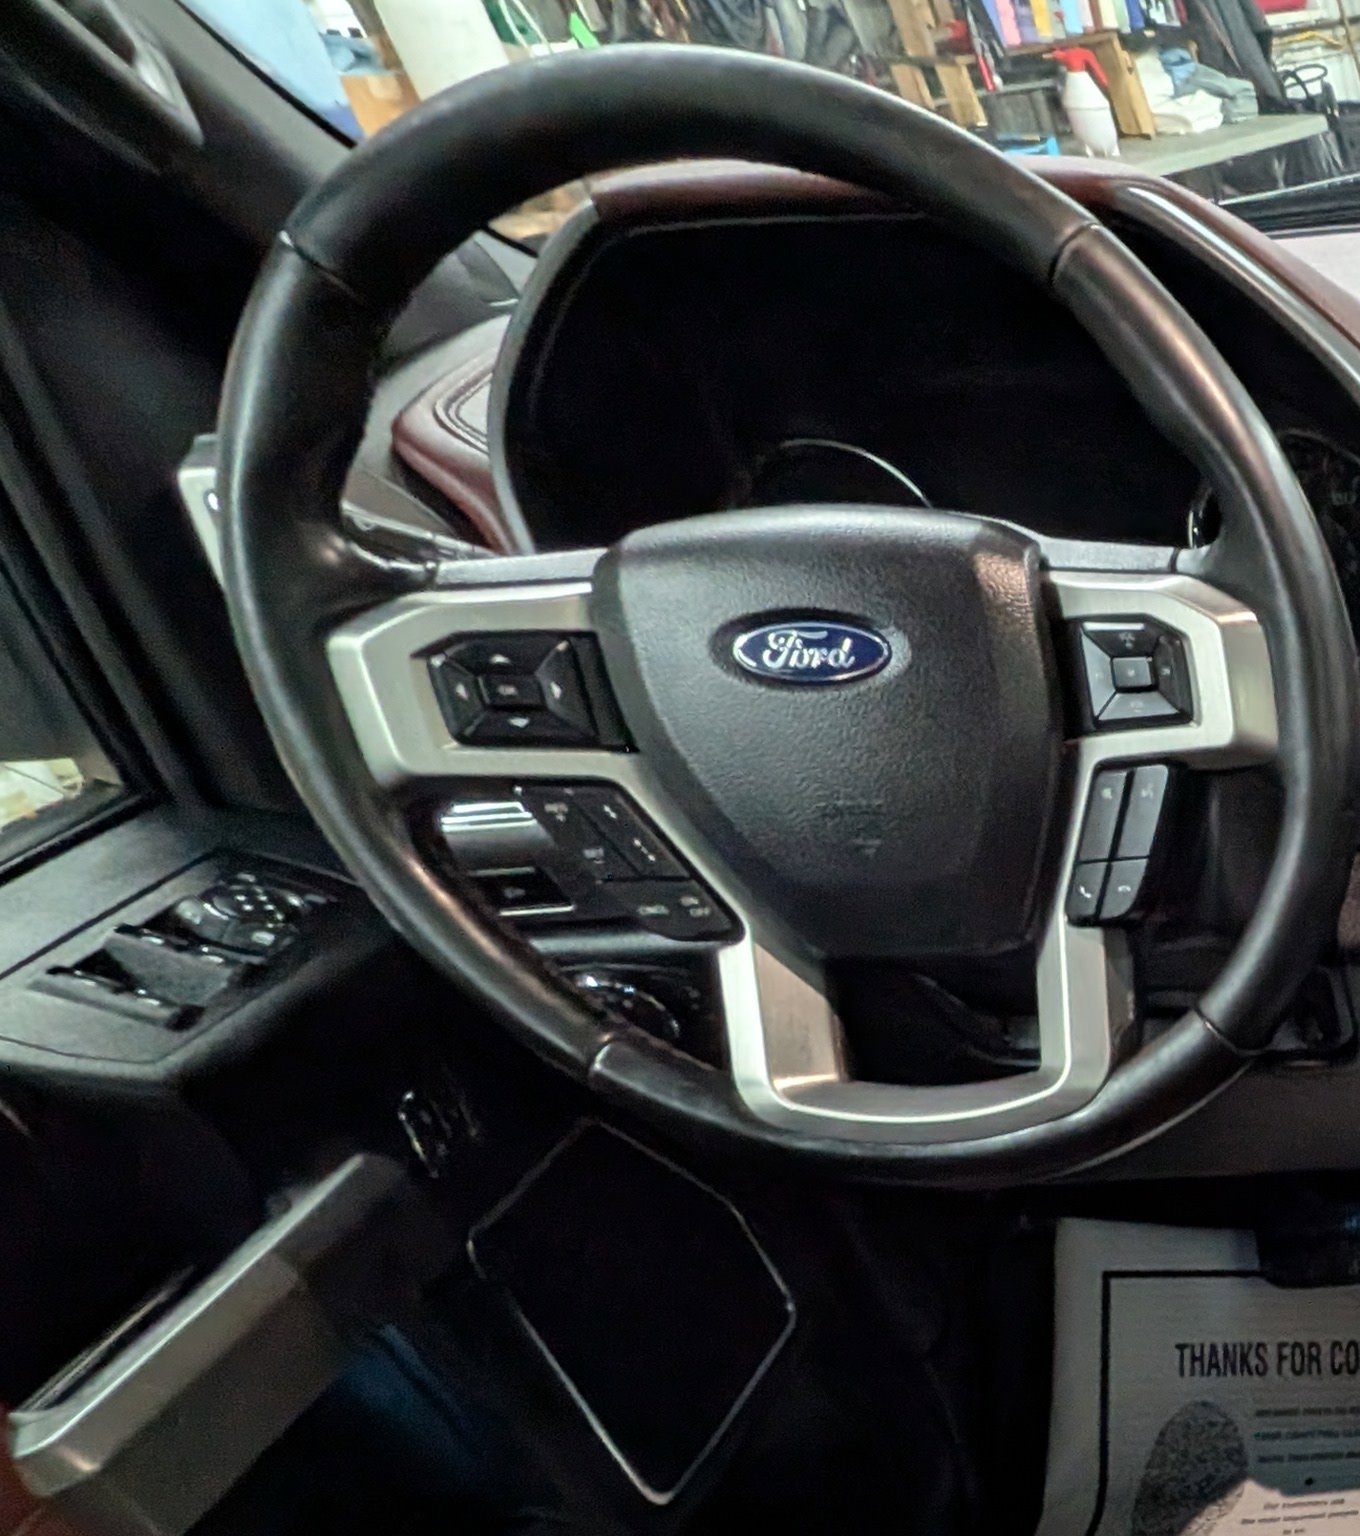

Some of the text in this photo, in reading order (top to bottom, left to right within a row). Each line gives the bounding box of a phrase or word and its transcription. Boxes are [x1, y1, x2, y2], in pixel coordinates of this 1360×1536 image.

[762, 630, 856, 669] Ford
[1175, 1341, 1268, 1378] THANKS
[1276, 1340, 1322, 1377] FOR
